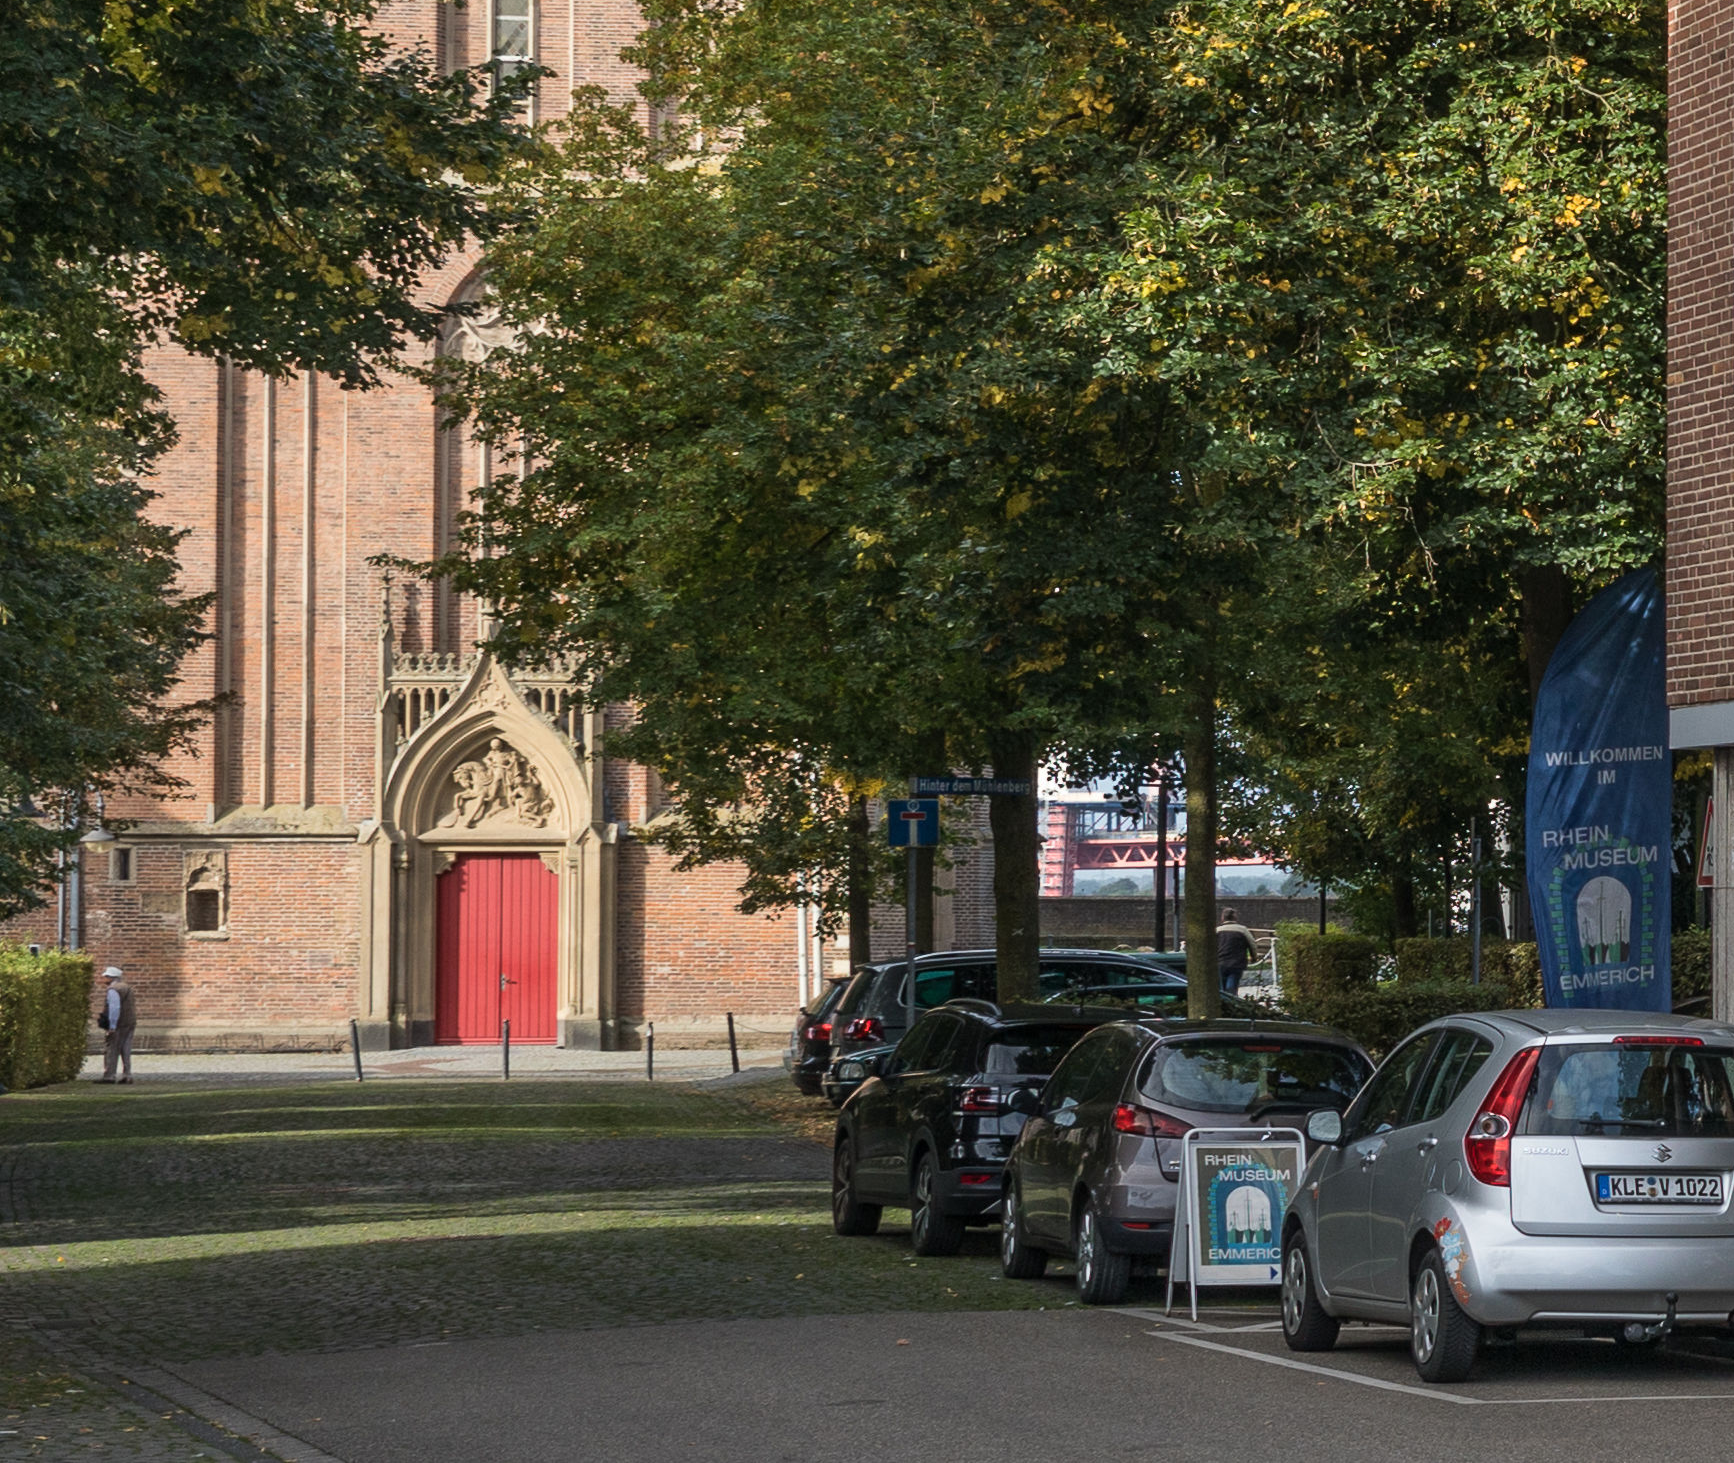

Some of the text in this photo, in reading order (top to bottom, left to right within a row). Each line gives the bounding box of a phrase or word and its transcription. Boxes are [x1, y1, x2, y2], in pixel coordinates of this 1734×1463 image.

[1545, 745, 1663, 766] WILLKOMMEN
[1597, 769, 1616, 784] IM
[920, 779, 949, 792] Hinter
[953, 779, 972, 792] dem
[1542, 825, 1609, 847] RHEIN
[1563, 846, 1658, 871] MUSEUM
[1560, 965, 1654, 991] EMMERICH
[1523, 1146, 1569, 1156] SUZUKI
[1204, 1154, 1251, 1166] RHEIN
[1218, 1169, 1290, 1181] MUSEUM
[1611, 1178, 1719, 1197] KLE V 1022
[1208, 1247, 1281, 1260] EMMERIC
